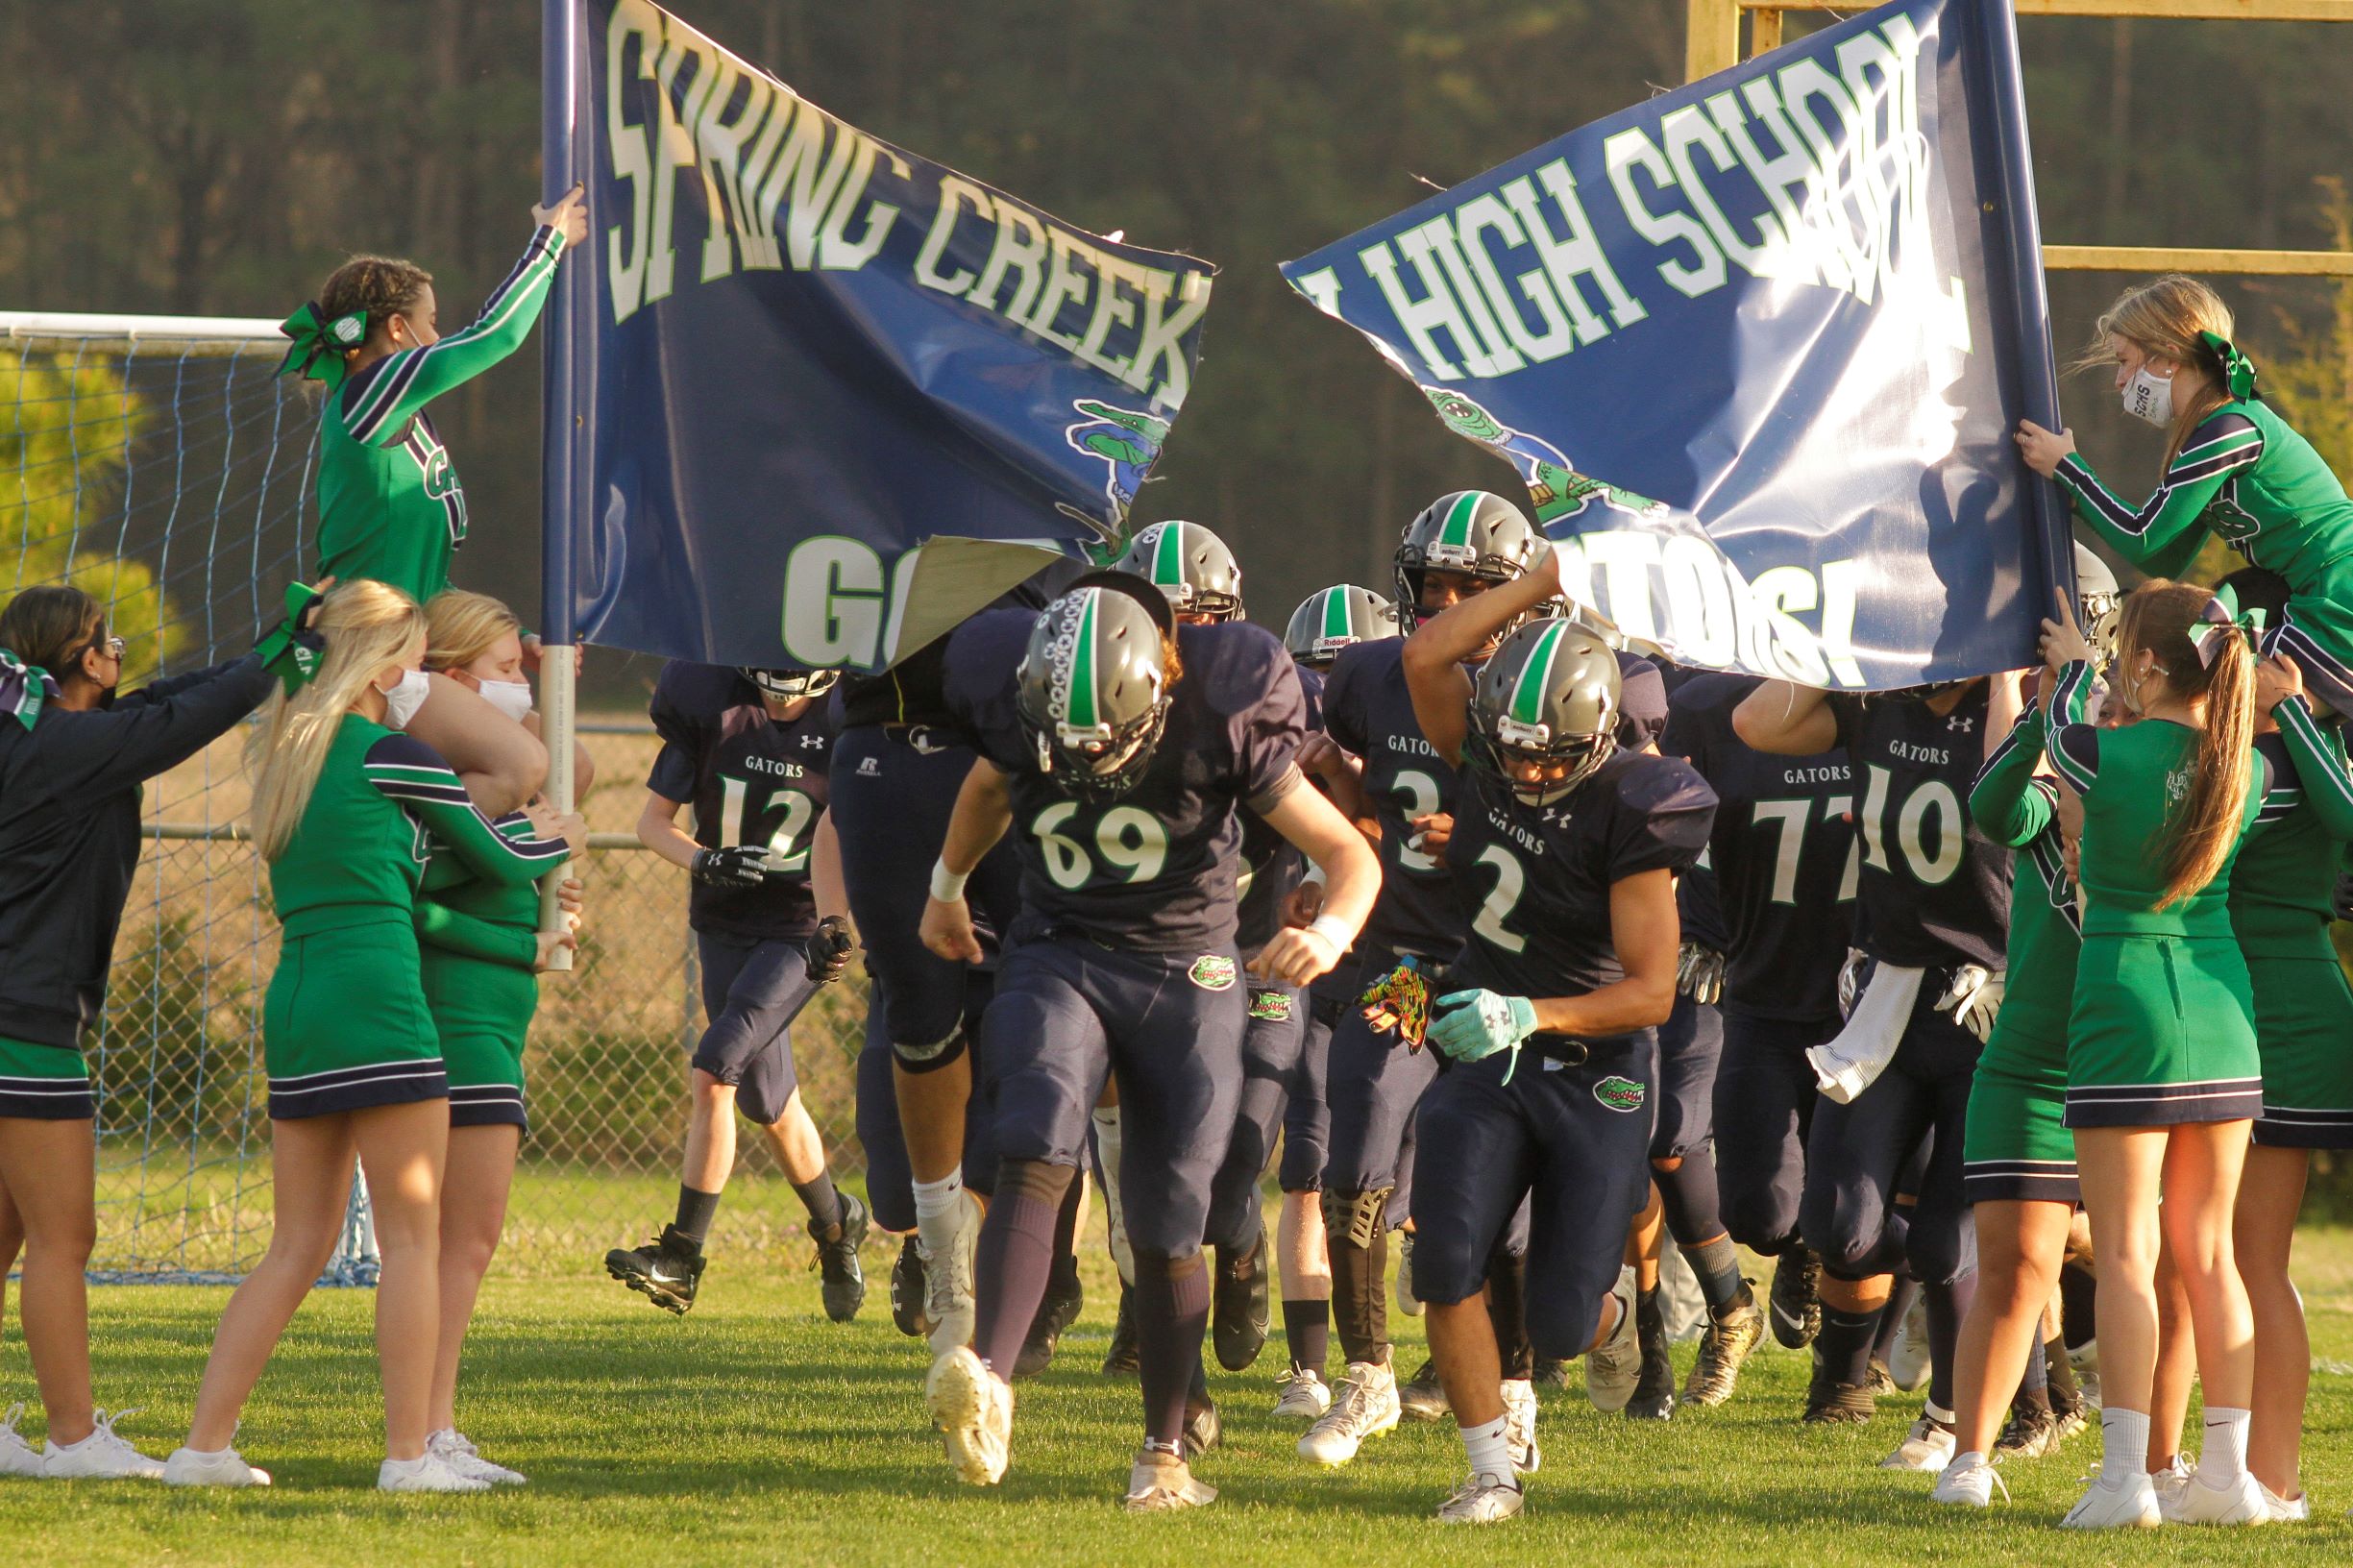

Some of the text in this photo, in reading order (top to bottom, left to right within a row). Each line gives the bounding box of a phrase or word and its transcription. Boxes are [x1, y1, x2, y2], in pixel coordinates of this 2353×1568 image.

[607, 0, 1213, 412] SPRING CREEK
[1357, 12, 1974, 381] HIGH SCHOOL
[2134, 383, 2150, 418] SCHS
[745, 755, 803, 777] GATORS
[1783, 765, 1851, 784] GATORS
[1889, 739, 1949, 765] GATORS
[719, 773, 814, 872] 12
[1030, 800, 1169, 891] 69
[1861, 762, 1964, 885] 10
[1471, 844, 1526, 954] 2
